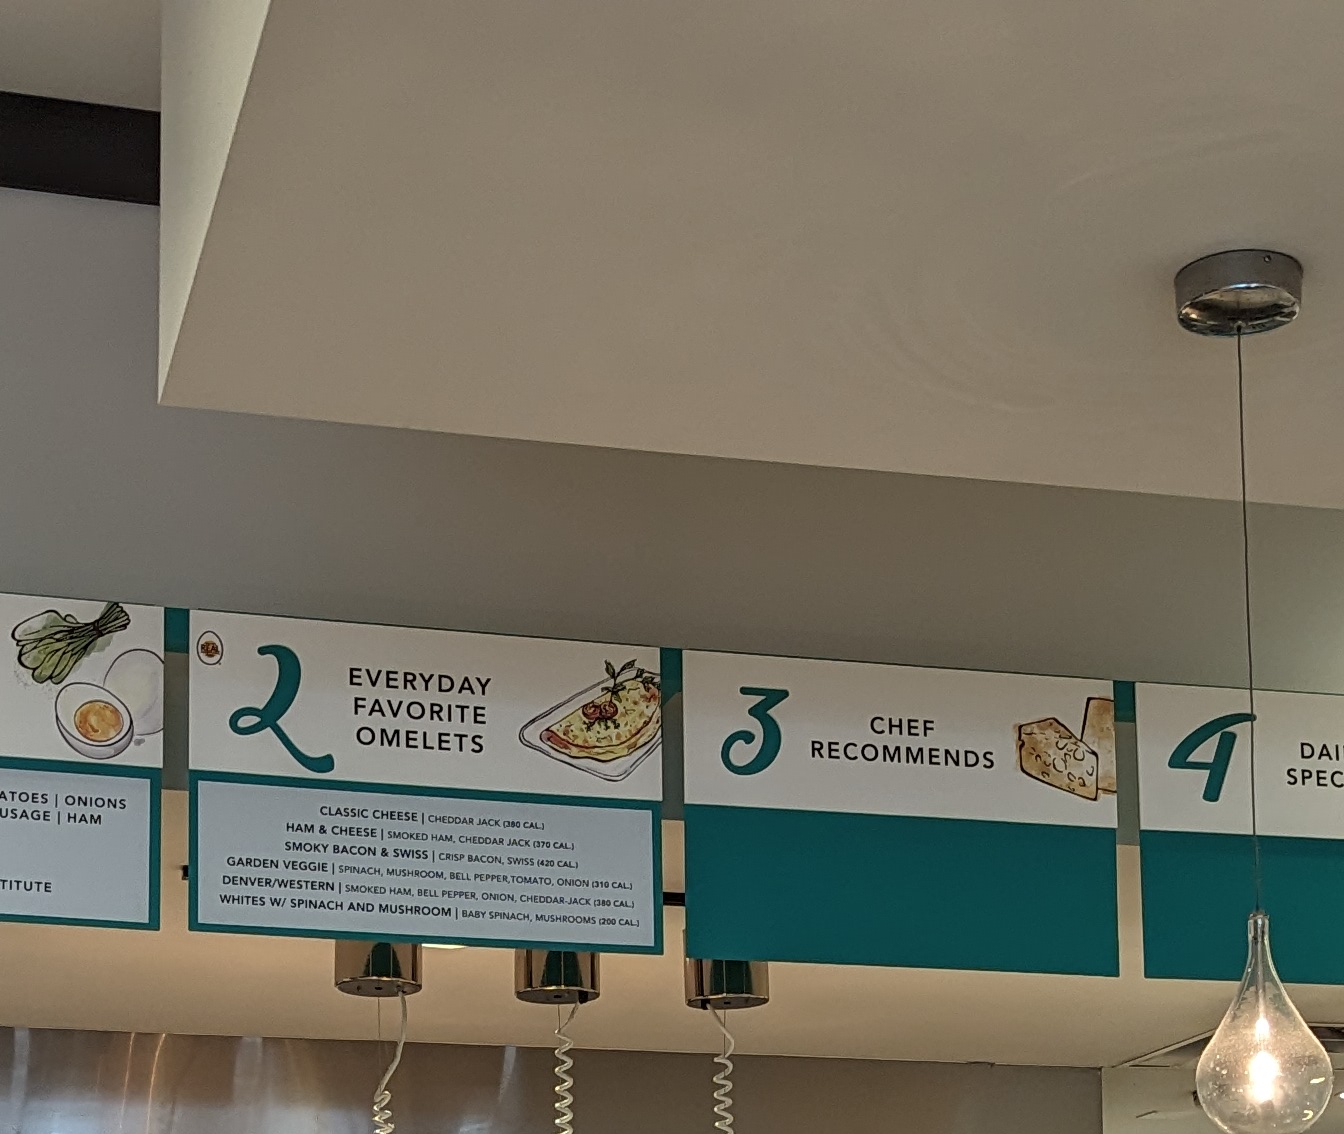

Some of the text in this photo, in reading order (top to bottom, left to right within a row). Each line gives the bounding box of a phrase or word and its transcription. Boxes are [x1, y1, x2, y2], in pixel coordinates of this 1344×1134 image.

[349, 666, 492, 697] EVERYDAY
[228, 643, 335, 774] 2
[353, 696, 487, 726] FAVORITE
[356, 725, 484, 755] OMELETS
[720, 686, 790, 776] 3
[869, 715, 935, 738] CHEF
[811, 740, 995, 770] RECOMMENDS
[1167, 712, 1257, 803] 4
[64, 794, 127, 811] ONIONS
[319, 805, 369, 820] CLASSIC
[372, 809, 419, 823] CHEESE
[427, 814, 475, 826] CHEDDAR
[476, 817, 501, 828] JACK
[67, 811, 102, 826] HAM
[286, 821, 315, 834] HAM
[318, 823, 328, 835] &
[331, 824, 378, 839] CHEESE
[387, 829, 429, 842] SMOKED
[430, 832, 456, 845] HAM,
[458, 834, 505, 846] CHEDDAR
[506, 837, 531, 849] JACK
[284, 840, 330, 854] SMOKY
[332, 843, 377, 858] BACON
[380, 846, 389, 859] &
[392, 847, 429, 861] SWISS
[438, 852, 465, 863] CRISP
[467, 853, 505, 866] BACON,
[506, 855, 535, 867] SWISS
[226, 855, 279, 870] GARDEN
[282, 858, 329, 873] VEGGIE
[338, 864, 384, 878] SPINACH,
[386, 867, 447, 881] MUSHROOM,
[449, 870, 472, 882] BELL
[556, 877, 590, 888] ONION
[222, 874, 335, 893] DENVER/WESTERN
[344, 883, 387, 896] SMOKED
[389, 886, 415, 898] HAM,
[417, 887, 440, 899] BELL
[441, 889, 479, 902] PEPPER,
[481, 891, 518, 904] ONION,
[519, 893, 592, 907] CHEDDAR-JACK
[219, 893, 266, 907] WHITES
[269, 896, 287, 908] W/
[290, 897, 344, 912] SPINACH
[347, 901, 375, 914] AND
[378, 902, 452, 918] MUSHROOM
[461, 909, 487, 920] BABY
[488, 909, 533, 924] SPINACH,
[535, 913, 597, 926] MUSHROOMS
